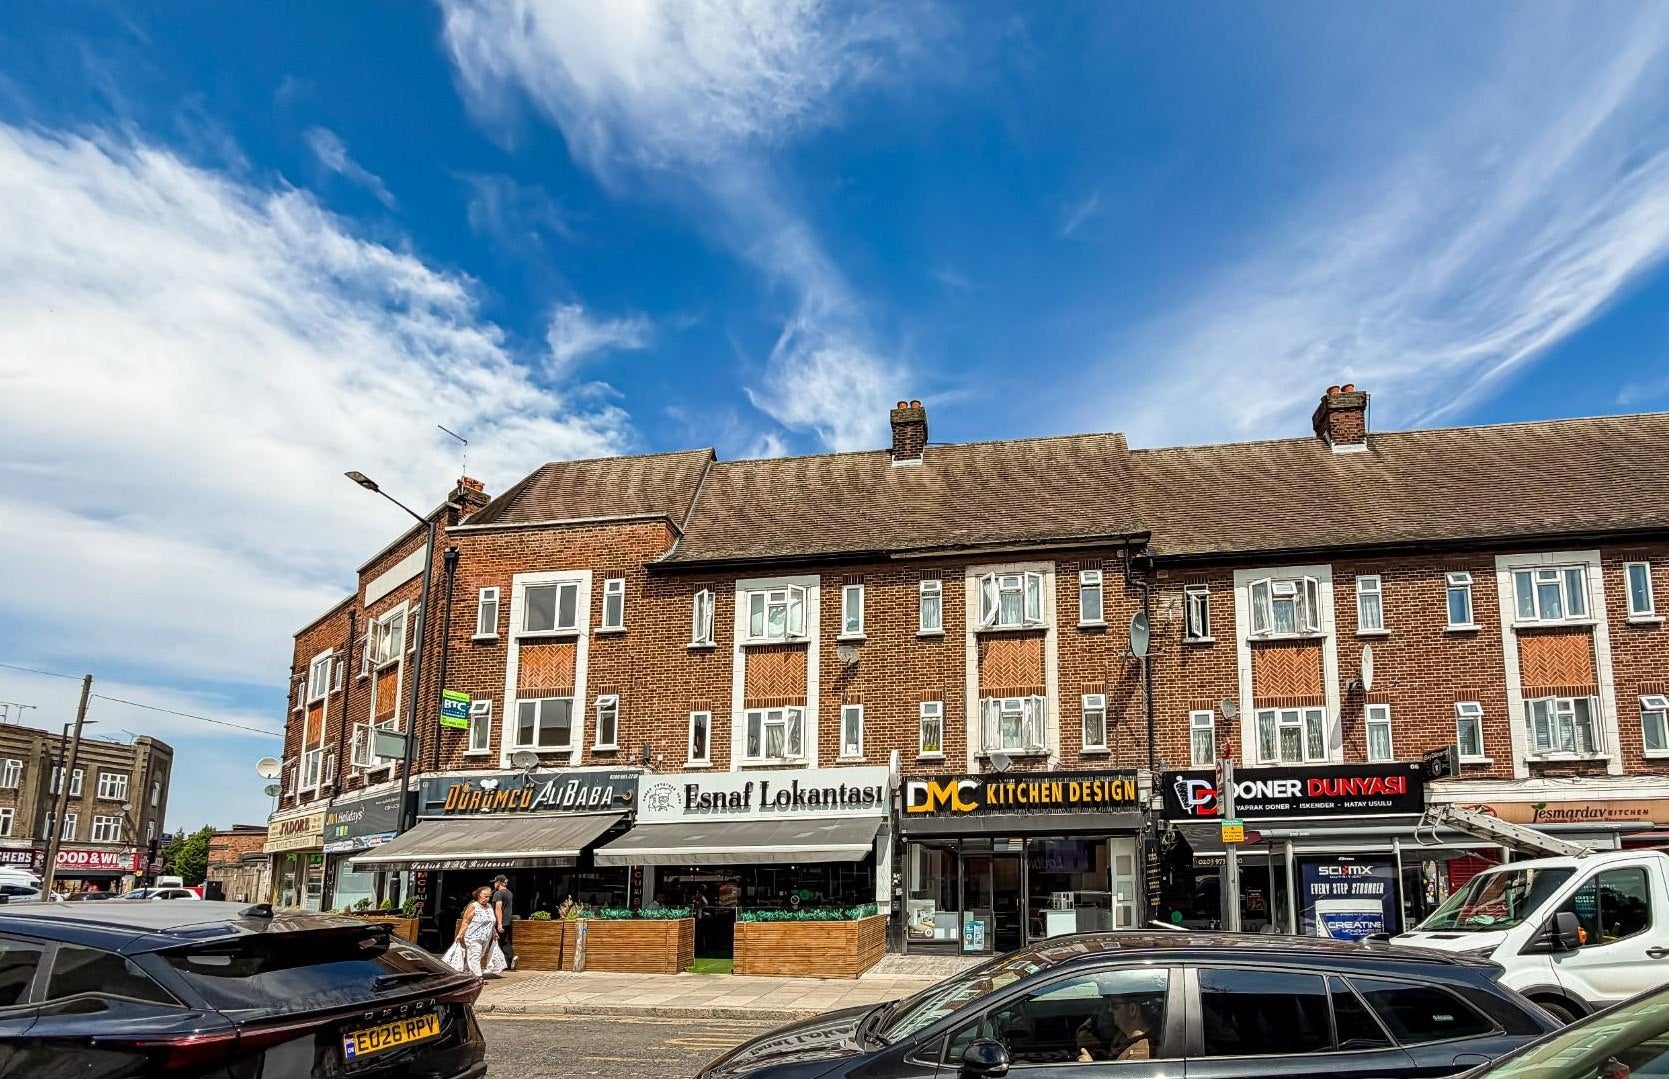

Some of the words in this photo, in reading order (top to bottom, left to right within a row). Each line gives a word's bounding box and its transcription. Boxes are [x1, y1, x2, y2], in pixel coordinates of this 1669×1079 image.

[444, 699, 466, 711] BTC
[1307, 776, 1407, 797] DUNYASI
[684, 782, 753, 811] Esnaf
[760, 780, 883, 809] Lokantası
[907, 779, 983, 813] DMC
[986, 783, 1062, 804] KITCHEN
[1069, 780, 1135, 802] DESIGN
[0, 852, 33, 863] HERS
[57, 852, 88, 863] OOD
[90, 852, 100, 863] &
[410, 860, 441, 869] Turkish
[469, 859, 515, 868] Restaurant
[1311, 883, 1329, 895] EVERY
[1333, 883, 1348, 894] STEP
[1352, 883, 1384, 894] STRONGER
[1328, 921, 1381, 929] CREATINE
[406, 1016, 434, 1040] RPV
